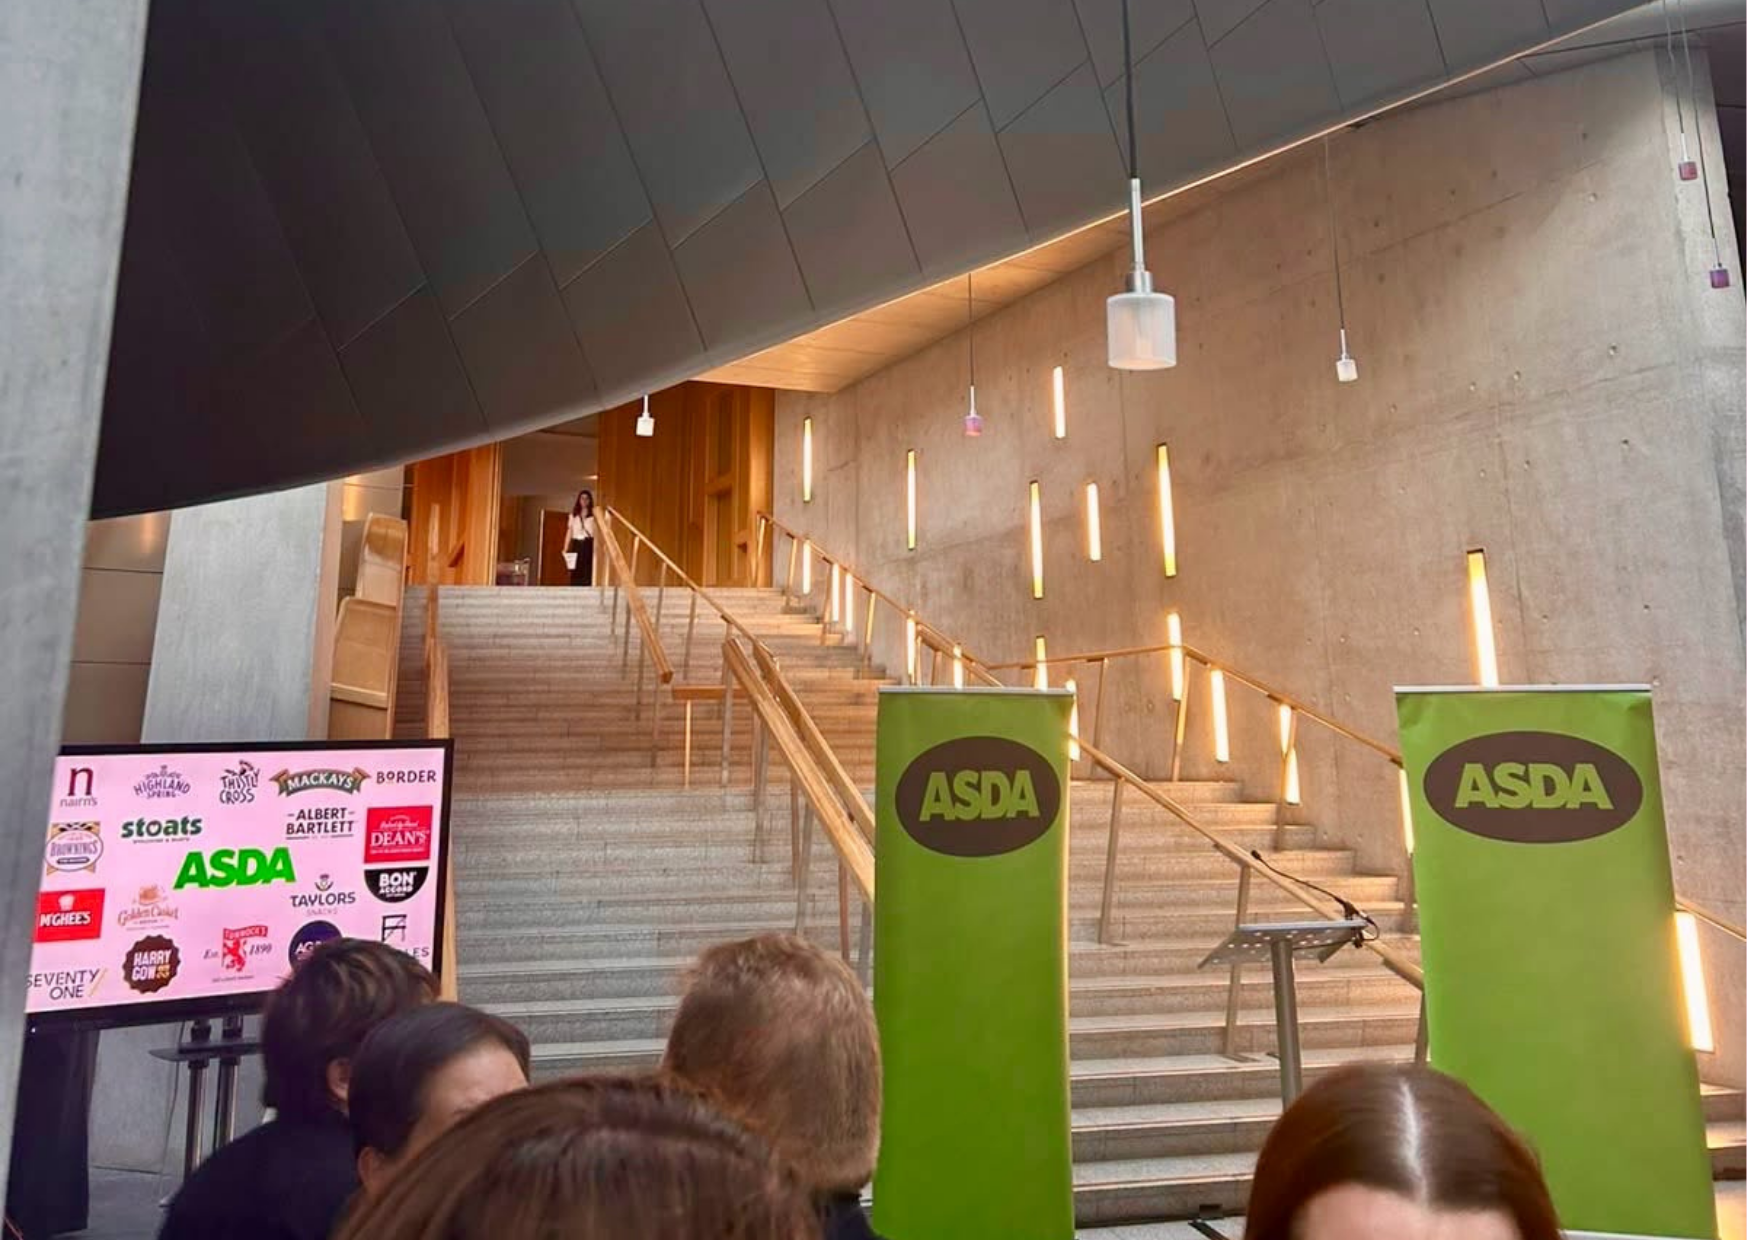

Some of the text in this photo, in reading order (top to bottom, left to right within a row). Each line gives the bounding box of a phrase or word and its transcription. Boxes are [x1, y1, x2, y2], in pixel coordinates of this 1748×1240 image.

[133, 778, 191, 799] HIGHLAND
[286, 772, 354, 792] MACKAYS
[1455, 762, 1614, 810] ASDA
[219, 788, 255, 804] CROSS
[919, 769, 1041, 822] ASDA
[296, 808, 347, 821] ALBERT
[121, 816, 203, 839] stoats
[286, 821, 354, 835] BARTLETT
[173, 847, 297, 889] ASDA
[379, 872, 415, 887] BON
[291, 892, 356, 907] TAYLORS
[133, 950, 172, 966] HARRY
[49, 984, 84, 1001] ONE
